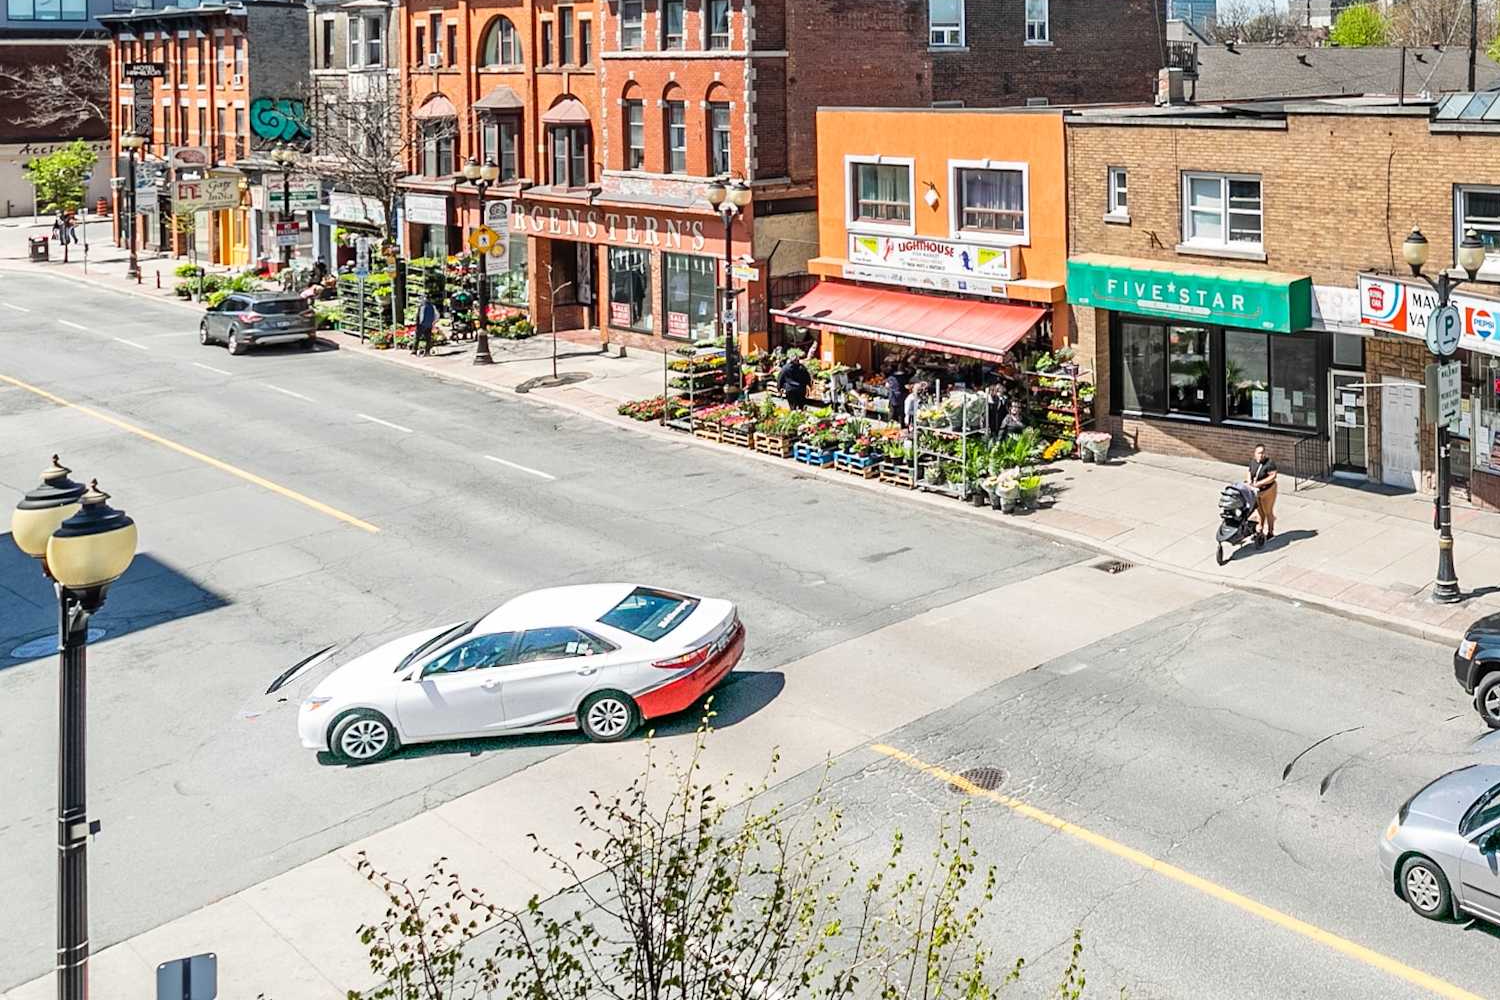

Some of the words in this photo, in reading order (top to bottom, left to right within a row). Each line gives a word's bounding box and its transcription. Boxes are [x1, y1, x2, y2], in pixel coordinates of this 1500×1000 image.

[513, 203, 705, 251] RGENSTERN'S
[898, 240, 955, 257] LIGHTHOUSE
[1107, 279, 1164, 301] FIVE
[1179, 288, 1245, 312] STAR
[1445, 315, 1454, 337] P
[1473, 318, 1495, 329] PEPSI
